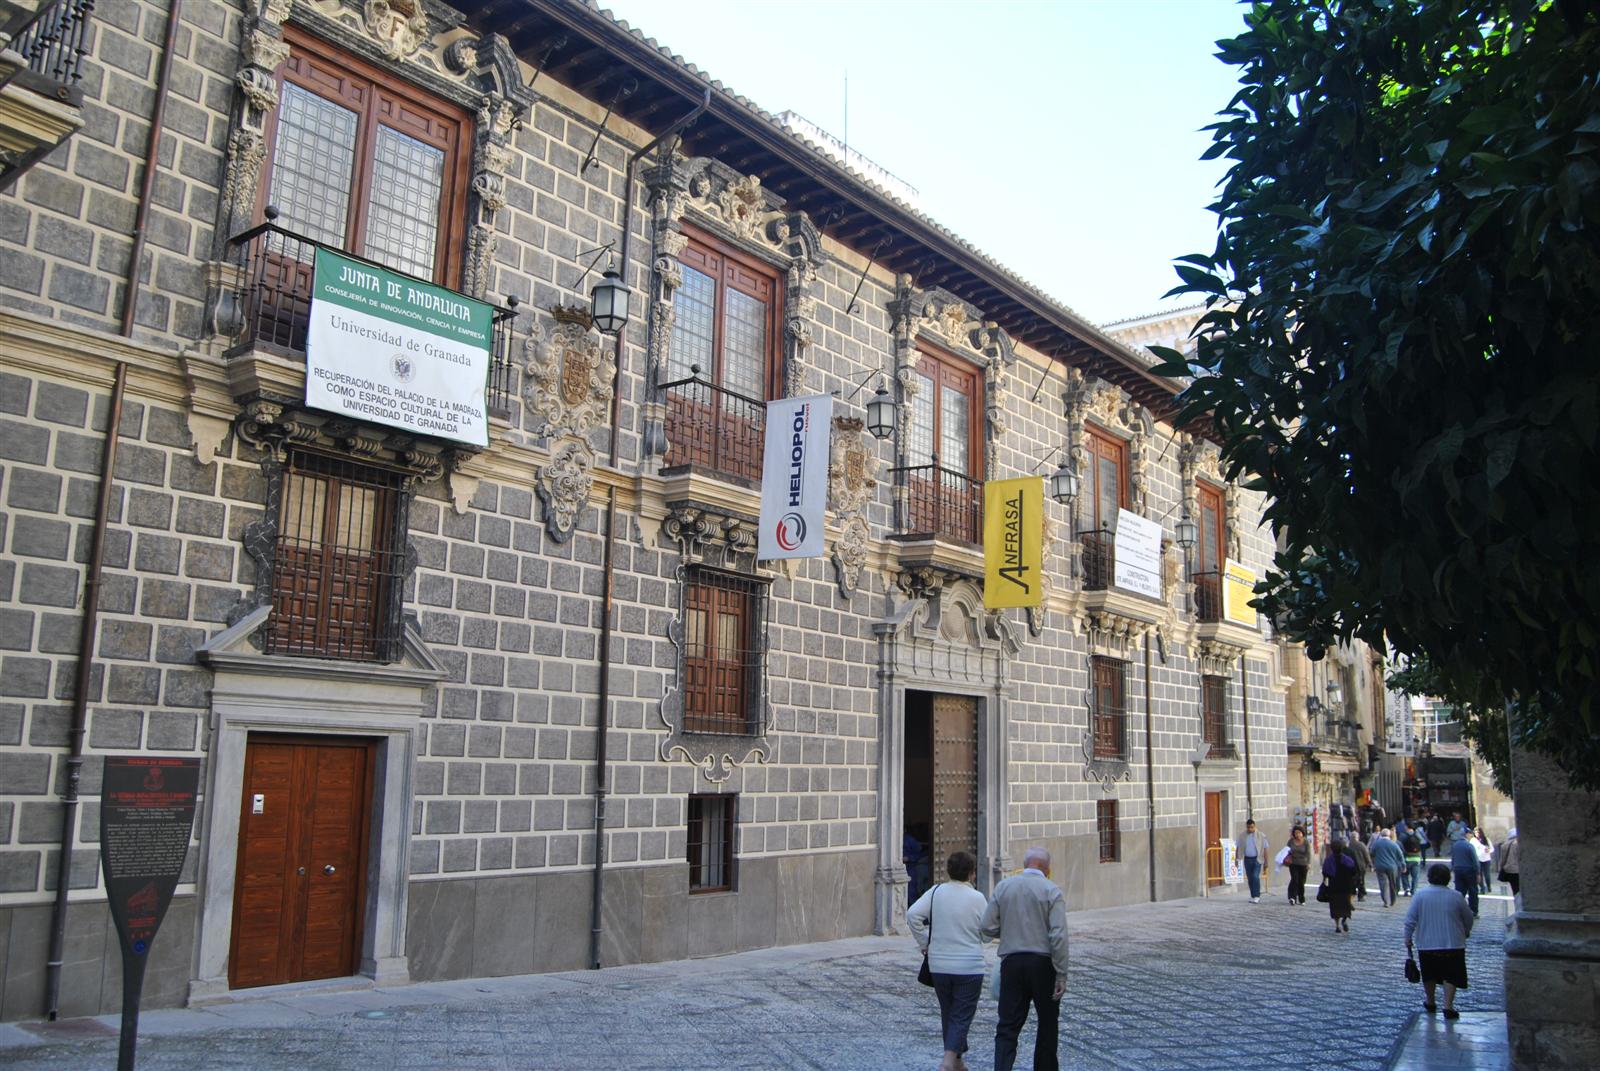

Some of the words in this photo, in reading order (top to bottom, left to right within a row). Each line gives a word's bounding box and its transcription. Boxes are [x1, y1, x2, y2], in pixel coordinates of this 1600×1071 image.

[339, 266, 380, 293] JUNTA
[387, 280, 402, 300] DE
[331, 315, 402, 347] Universidad
[406, 338, 420, 352] de
[424, 343, 472, 367] Granada
[368, 298, 379, 307] DE
[426, 317, 450, 330] CIENCIA
[451, 324, 457, 332] Y
[458, 327, 486, 341] EMPRESA
[314, 367, 375, 391] RECUPERACIÓN
[377, 384, 392, 396] DEL
[394, 389, 425, 404] PALACIO
[426, 397, 437, 407] DE
[439, 400, 450, 410] LA
[452, 403, 483, 419] MADRAZA
[326, 382, 356, 398] COMO
[359, 392, 397, 408] ESPACIO
[400, 401, 443, 420] CULTURAL
[446, 414, 459, 423] DE
[462, 416, 472, 426] LA
[343, 398, 401, 420] UNIVERSIDAD
[403, 414, 415, 424] DE
[417, 417, 458, 434] GRANADA
[789, 403, 806, 507] HELIOPOL
[999, 495, 1030, 595] ANFRASA
